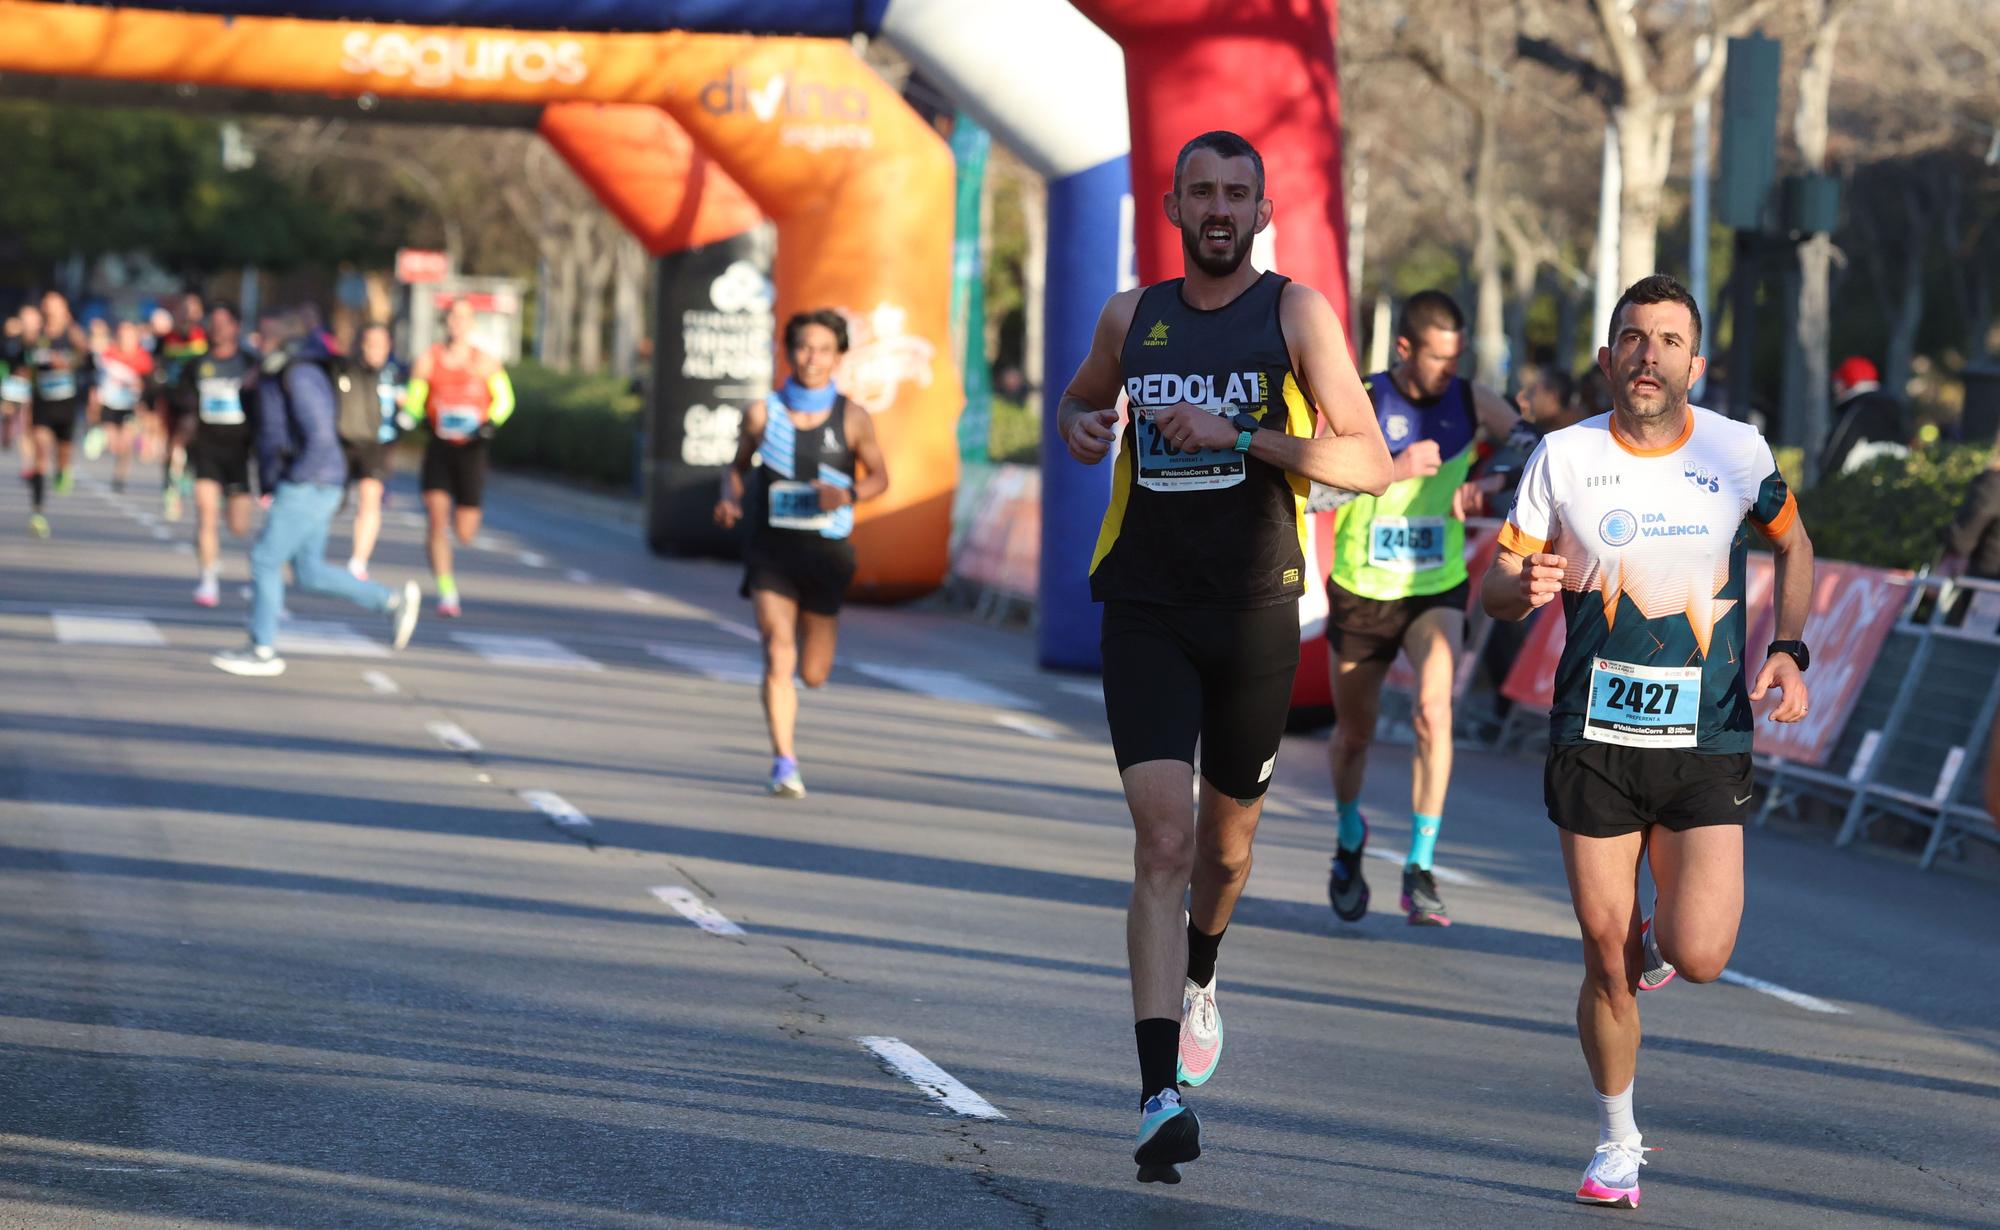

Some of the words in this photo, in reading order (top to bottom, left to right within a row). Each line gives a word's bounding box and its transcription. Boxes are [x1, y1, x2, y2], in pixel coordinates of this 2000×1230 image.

[341, 31, 588, 87] seguros
[1127, 372, 1260, 406] REDOLAT
[1259, 372, 1268, 402] TEAM
[1587, 475, 1621, 487] GOBIK
[1641, 513, 1666, 523] IDA
[1641, 525, 1710, 537] VALENCIA
[1606, 677, 1679, 715] 2427
[1626, 713, 1656, 721] PREFERENT
[1613, 723, 1664, 734] #ValènciaCorre
